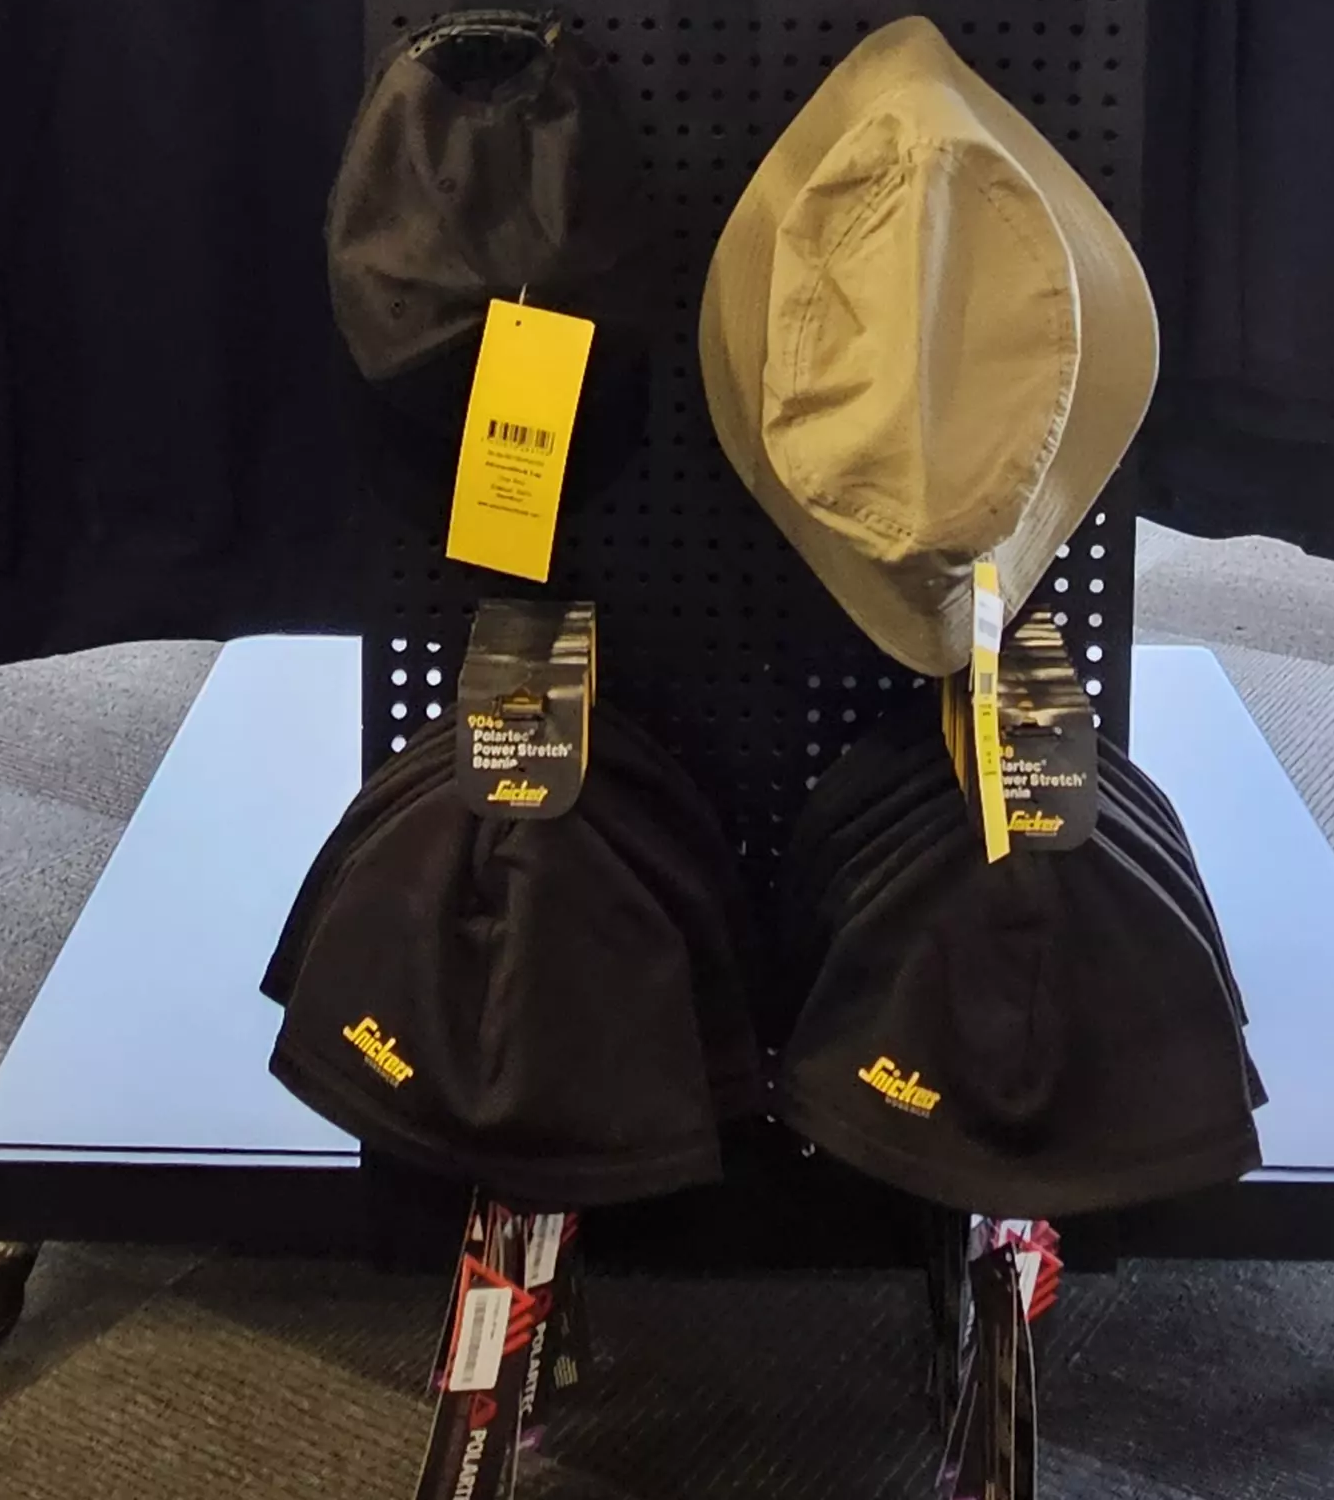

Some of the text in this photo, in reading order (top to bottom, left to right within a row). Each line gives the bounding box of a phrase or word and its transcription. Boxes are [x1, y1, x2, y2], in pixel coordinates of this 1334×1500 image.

[472, 742, 516, 756] Power
[472, 756, 518, 769] Beanie
[1002, 758, 1047, 773] lartec®
[1002, 775, 1028, 786] wer
[1003, 786, 1032, 800] anie
[342, 1017, 414, 1081] Snickers
[858, 1056, 942, 1110] Snickers
[453, 1427, 488, 1500] POLART
